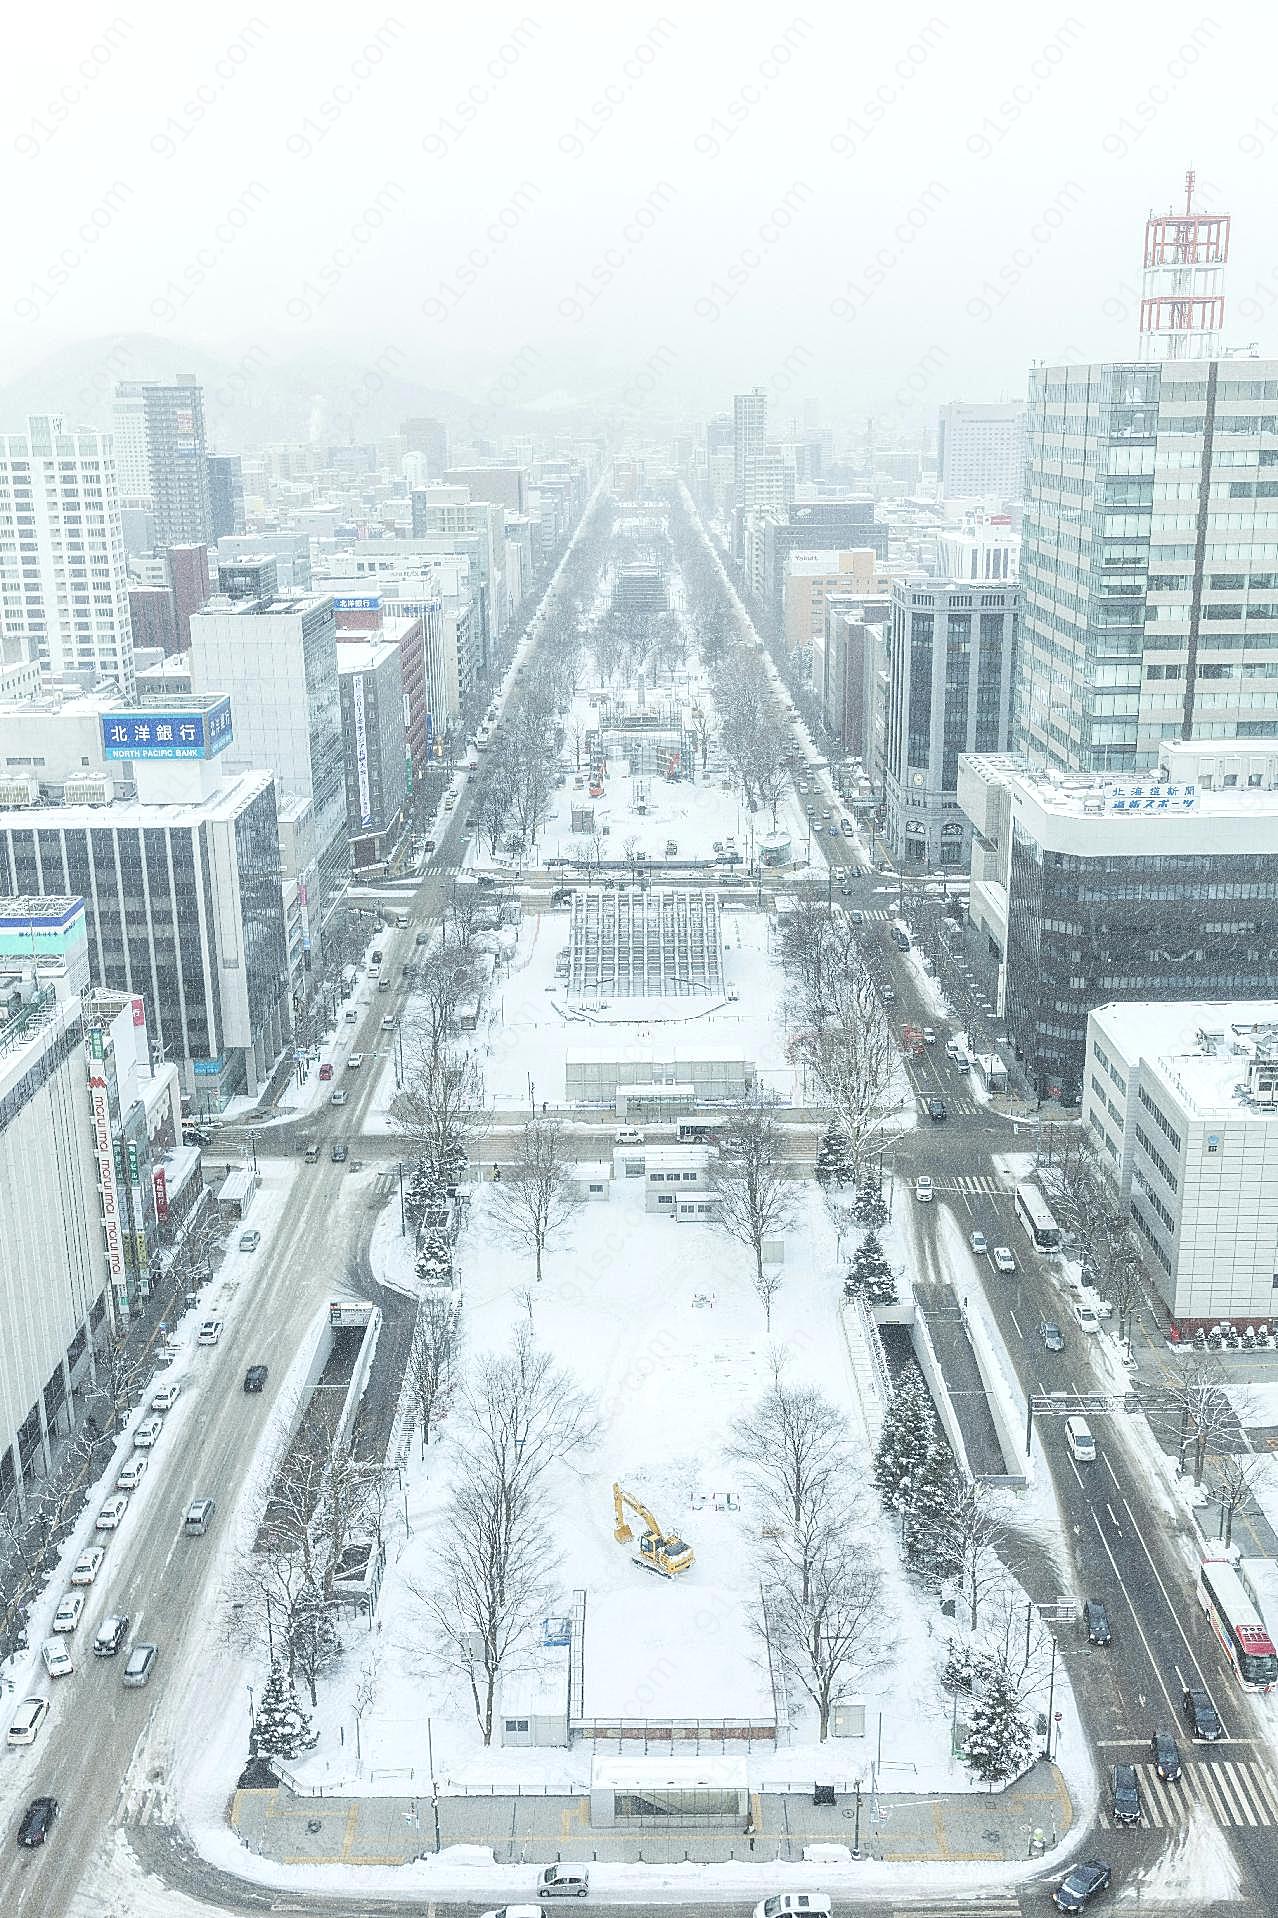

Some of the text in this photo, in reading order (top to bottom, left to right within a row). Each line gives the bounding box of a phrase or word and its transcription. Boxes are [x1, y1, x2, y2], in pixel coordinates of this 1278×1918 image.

[110, 724, 196, 742] 北洋銀行
[112, 749, 140, 758] NORTH
[142, 749, 173, 758] PACIFIC
[175, 749, 199, 757] BANK
[1112, 785, 1195, 796] 北海道新聞
[1111, 799, 1195, 809] 道新スポーツ
